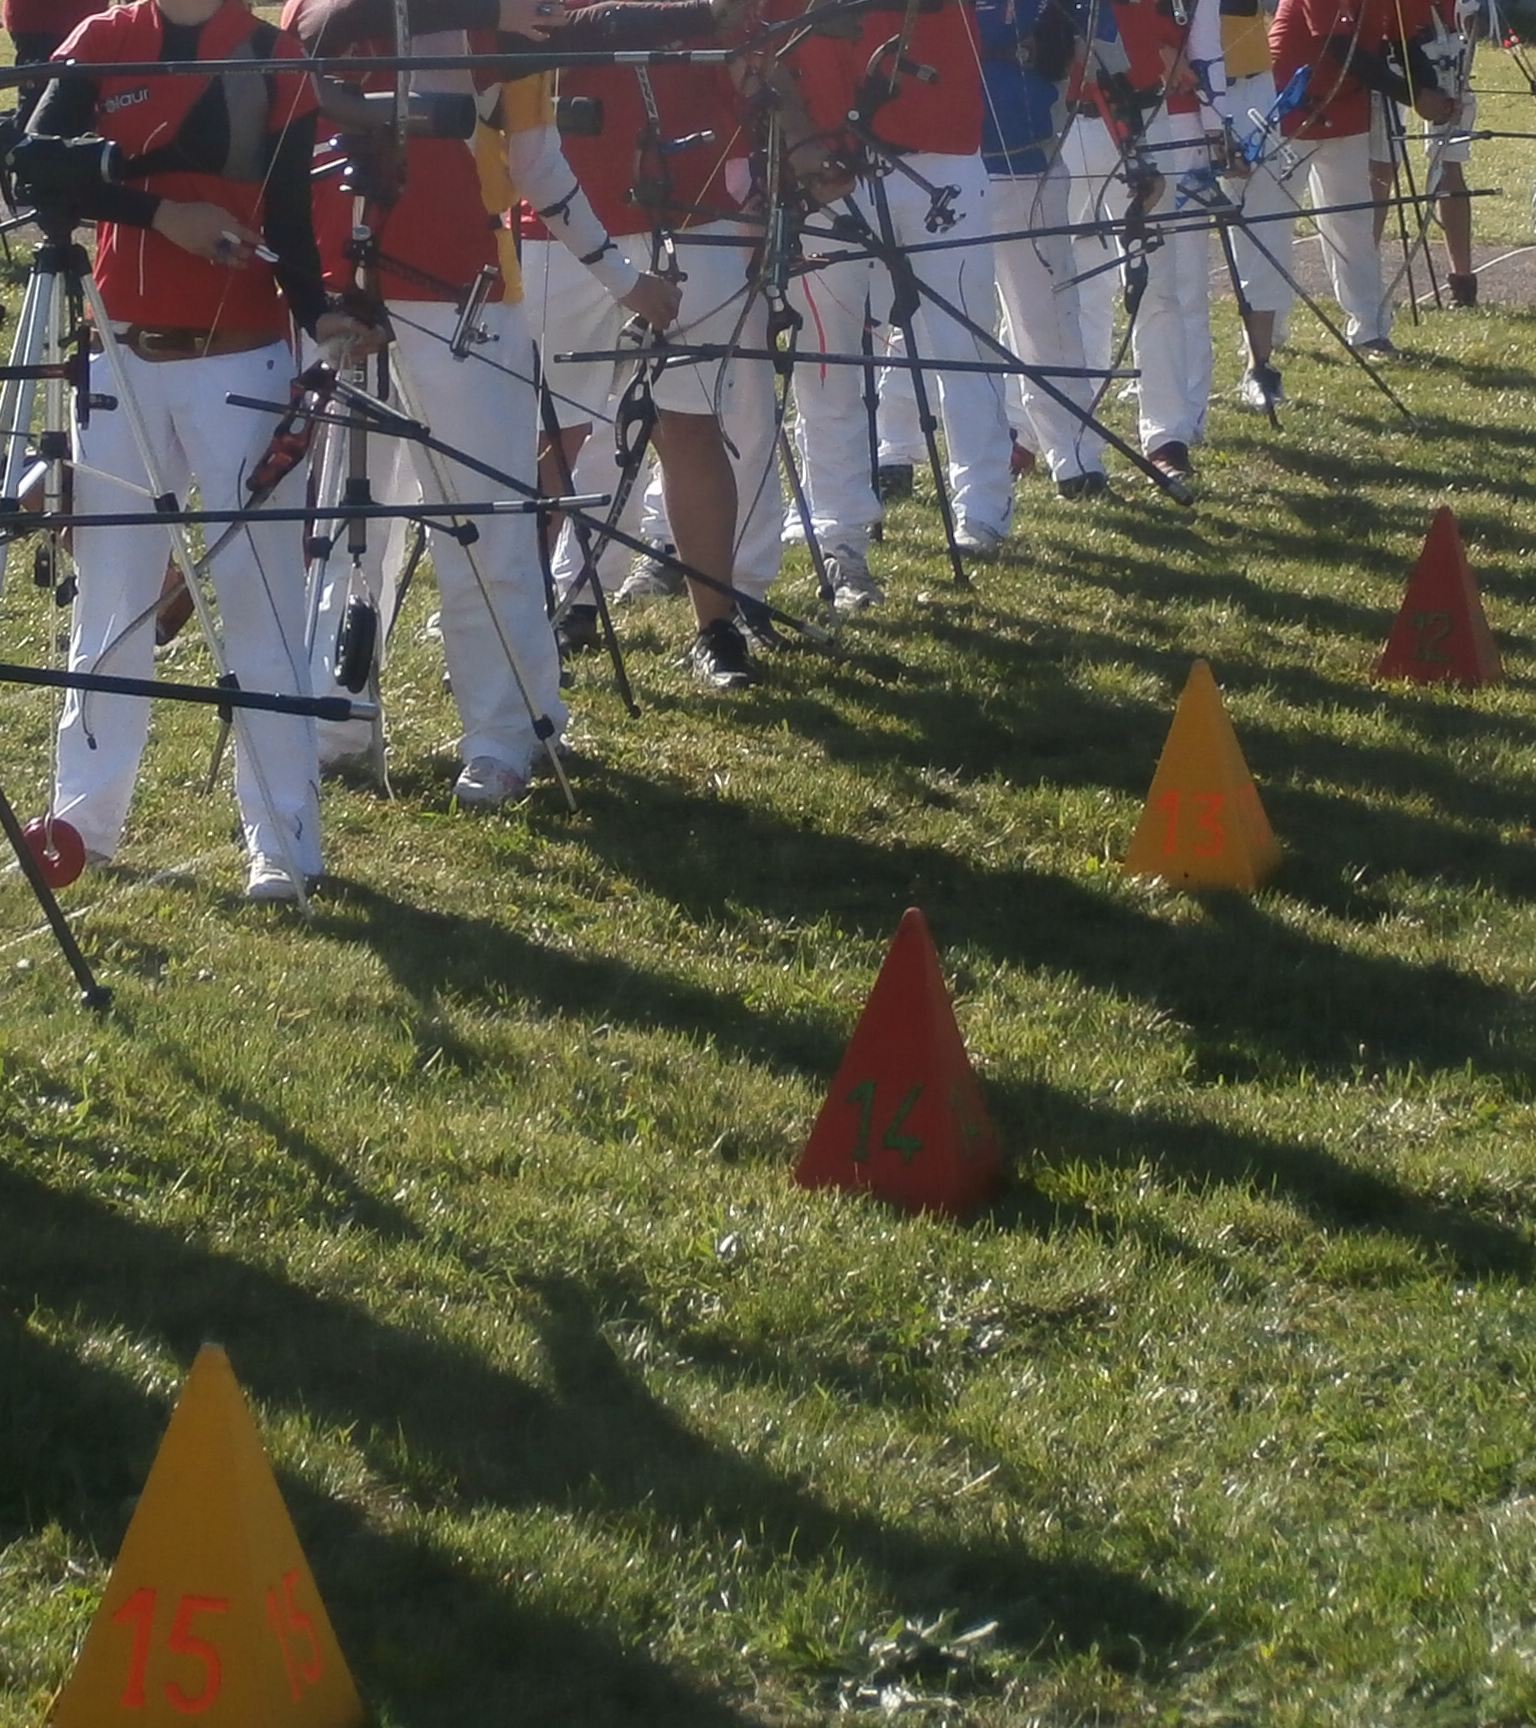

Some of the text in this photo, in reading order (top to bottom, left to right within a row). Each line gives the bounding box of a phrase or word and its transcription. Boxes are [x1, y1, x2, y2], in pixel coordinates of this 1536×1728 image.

[1410, 610, 1455, 664] 12
[1155, 790, 1227, 857] 13
[846, 1080, 925, 1164] 14
[113, 1586, 230, 1715] 15
[267, 1568, 324, 1704] 15
